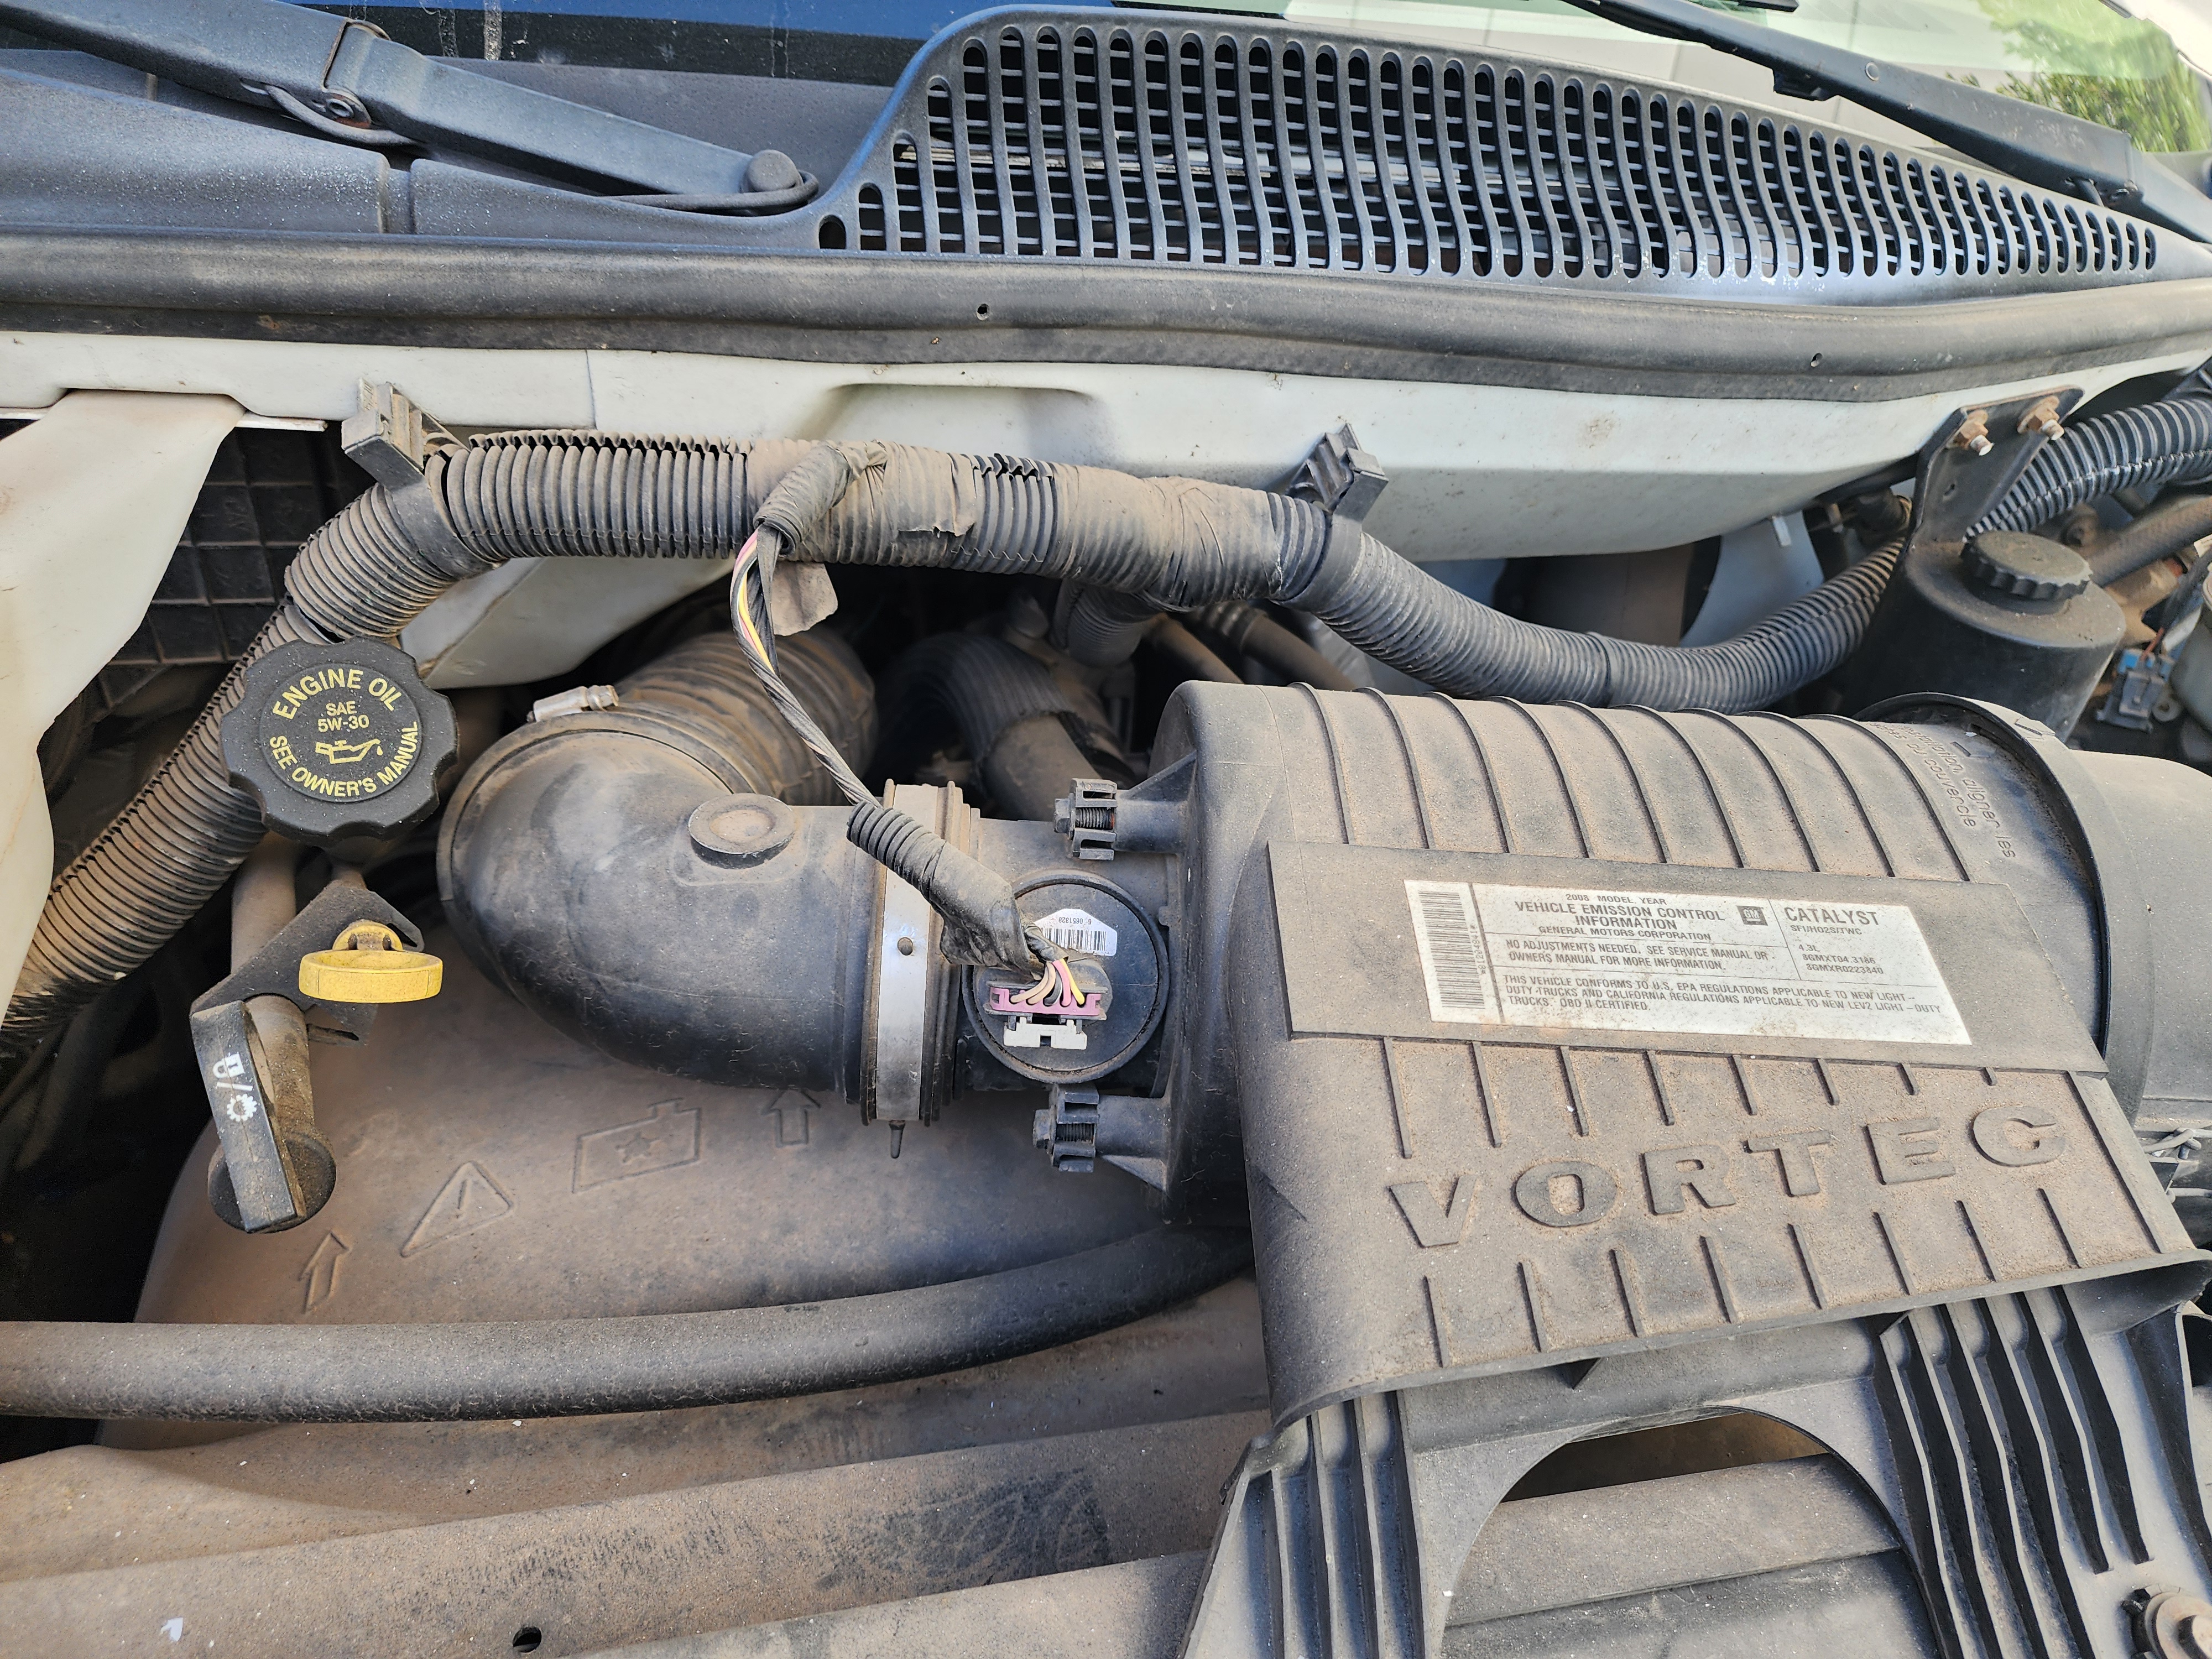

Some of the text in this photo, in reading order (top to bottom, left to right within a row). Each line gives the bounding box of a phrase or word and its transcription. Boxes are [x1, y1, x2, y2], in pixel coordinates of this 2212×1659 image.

[272, 668, 402, 719] ENGINE OIL
[326, 701, 357, 716] SAE
[317, 714, 369, 733] 5W-30
[269, 721, 418, 797] SEE OWNER'S MANUAL
[1924, 758, 1976, 828] couvercle
[1962, 779, 2000, 829] aligner
[1995, 834, 2016, 858] les
[1515, 901, 1725, 921] VEHICLE EMISSION CONTROL
[1639, 897, 1667, 905] YEAR
[1575, 915, 1677, 930] INFORMATION
[1783, 907, 1879, 925] CATALYST
[1539, 926, 1712, 941] GENERAL MOTORS CORPORATION
[1790, 925, 1863, 935] SFI/HO2S/TWC
[1506, 940, 1768, 960] NO ADJUSTMENTS NEEDED. SEE SERVICE MANUAL OR
[1798, 944, 1820, 952] 4.3L
[1509, 951, 1726, 971] OWNERS MANUAL FOR MORE INFORMATION.
[1503, 974, 1527, 984] THIS
[1529, 976, 1572, 987] VEHICLE
[1576, 978, 1632, 989] CONFORMS
[1635, 980, 1649, 989] TO
[1652, 981, 1674, 991] U.S.
[1677, 982, 1697, 992] EPA
[1699, 984, 1769, 995] REGULATIONS
[1772, 987, 1832, 999] APPLICABLE
[1833, 990, 1848, 999] TO
[1849, 990, 1874, 1000] NEW
[1876, 992, 1906, 1002] LIGHT
[1506, 985, 1532, 995] DUTY
[1537, 987, 1578, 997] TRUCKS
[1582, 988, 1603, 998] AND
[1606, 990, 1666, 1001] CALIFORNIA
[1669, 992, 1740, 1004] REGULATIONS
[1743, 996, 1802, 1007] APPLICABLE
[1805, 999, 1819, 1008] TO
[1822, 1000, 1844, 1009] NEW
[1848, 1001, 1872, 1010] LEV2
[1875, 1003, 1904, 1011] LIGHT
[1914, 1004, 1942, 1013] DUTY
[1559, 998, 1582, 1008] OBD
[1595, 1000, 1651, 1011] CERTIFIED.
[1388, 1106, 2066, 1249] VORTEC
